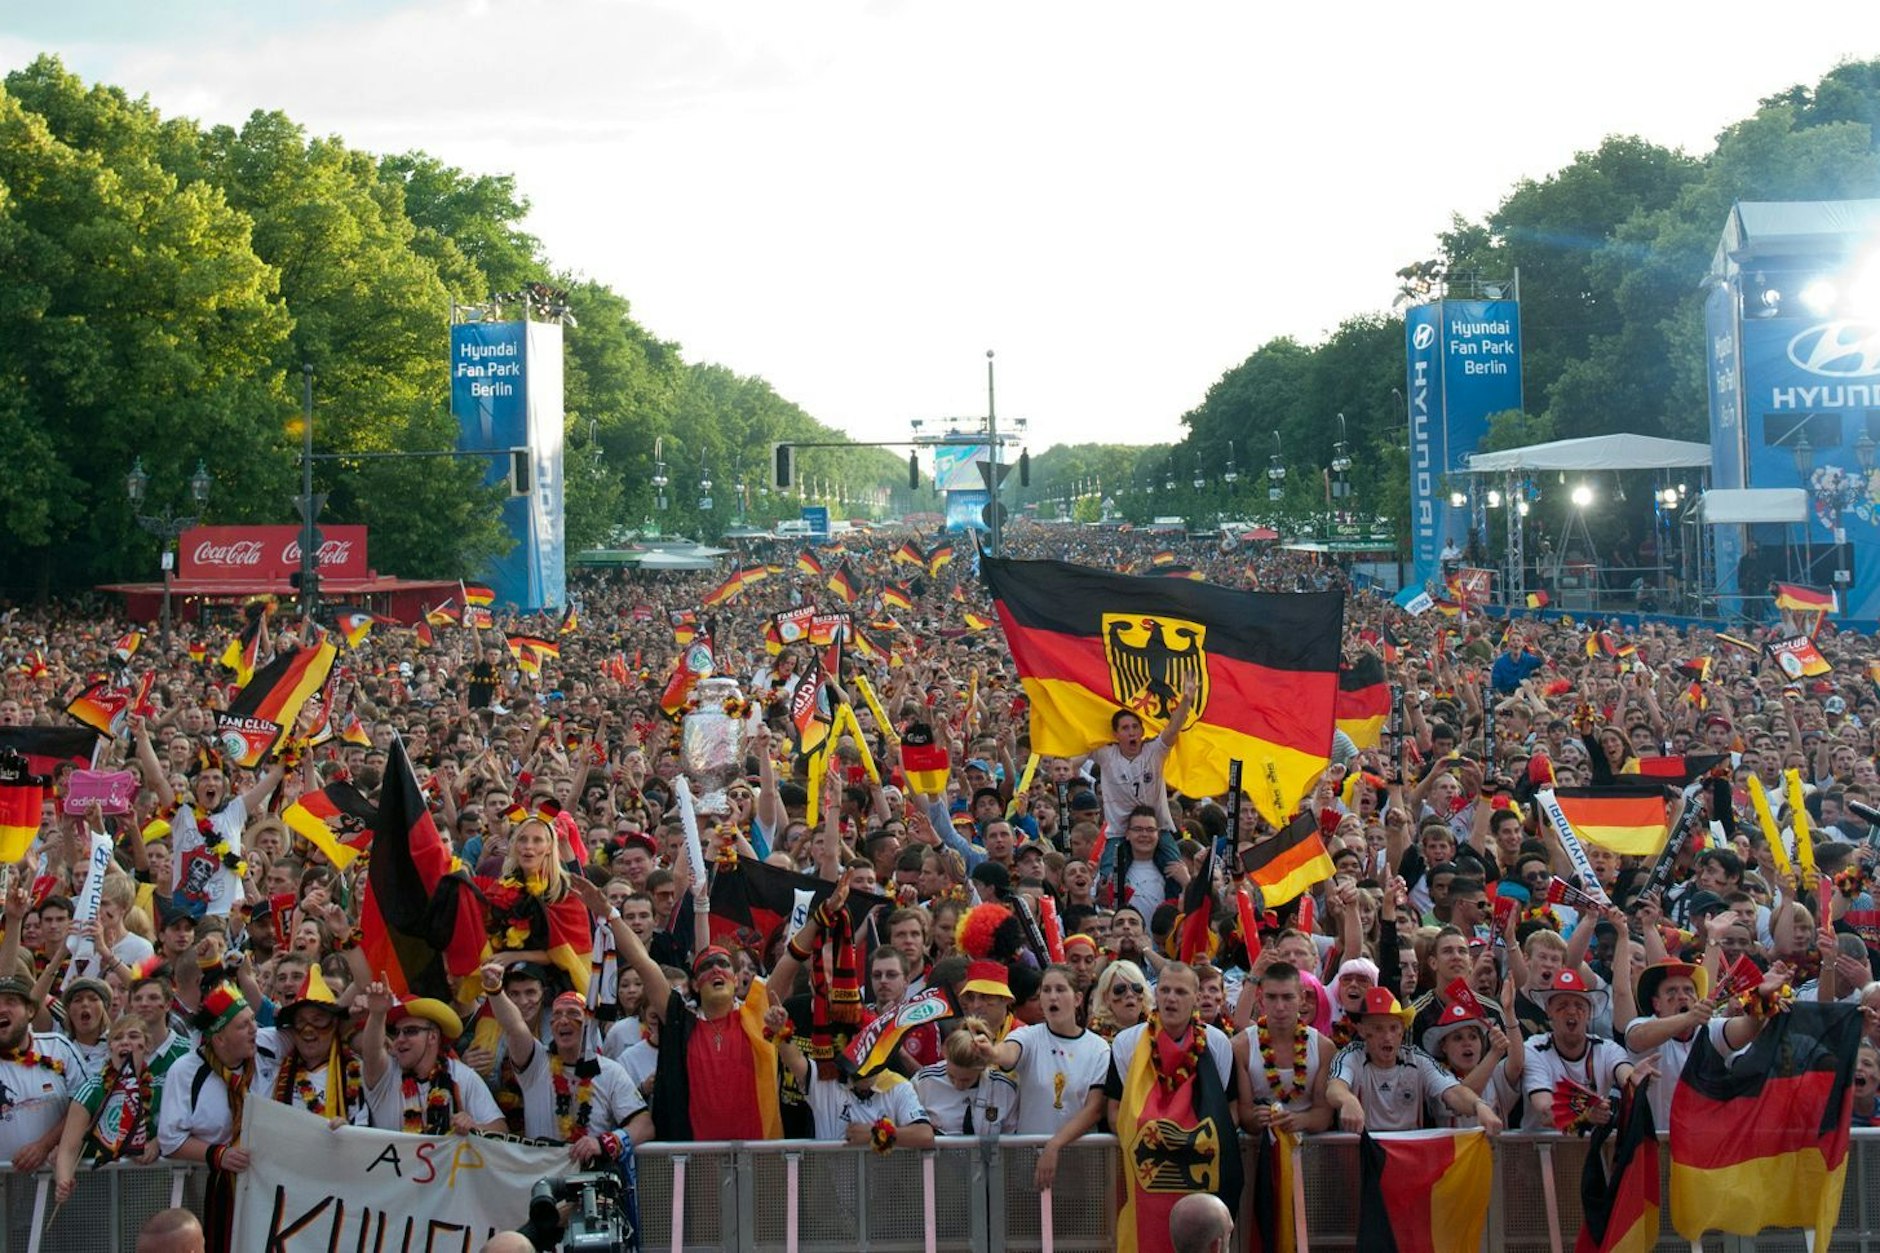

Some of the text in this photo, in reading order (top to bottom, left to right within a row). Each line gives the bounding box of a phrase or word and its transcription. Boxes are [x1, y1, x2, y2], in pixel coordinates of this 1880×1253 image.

[1451, 320, 1510, 338] Hyundai
[461, 342, 517, 360] Hyundai
[1450, 340, 1514, 355] Fan Park
[458, 361, 520, 378] Fan Park
[1465, 361, 1507, 374] Berlin
[471, 382, 513, 397] Berlin
[1414, 361, 1434, 537] HYUNDAI
[193, 540, 266, 565] Coca-Cola
[777, 605, 816, 622] FAN CLUB
[219, 714, 243, 728] FAN
[1132, 781, 1141, 798] 7
[70, 796, 108, 807] adidas
[1549, 804, 1587, 866] HYUNDAI
